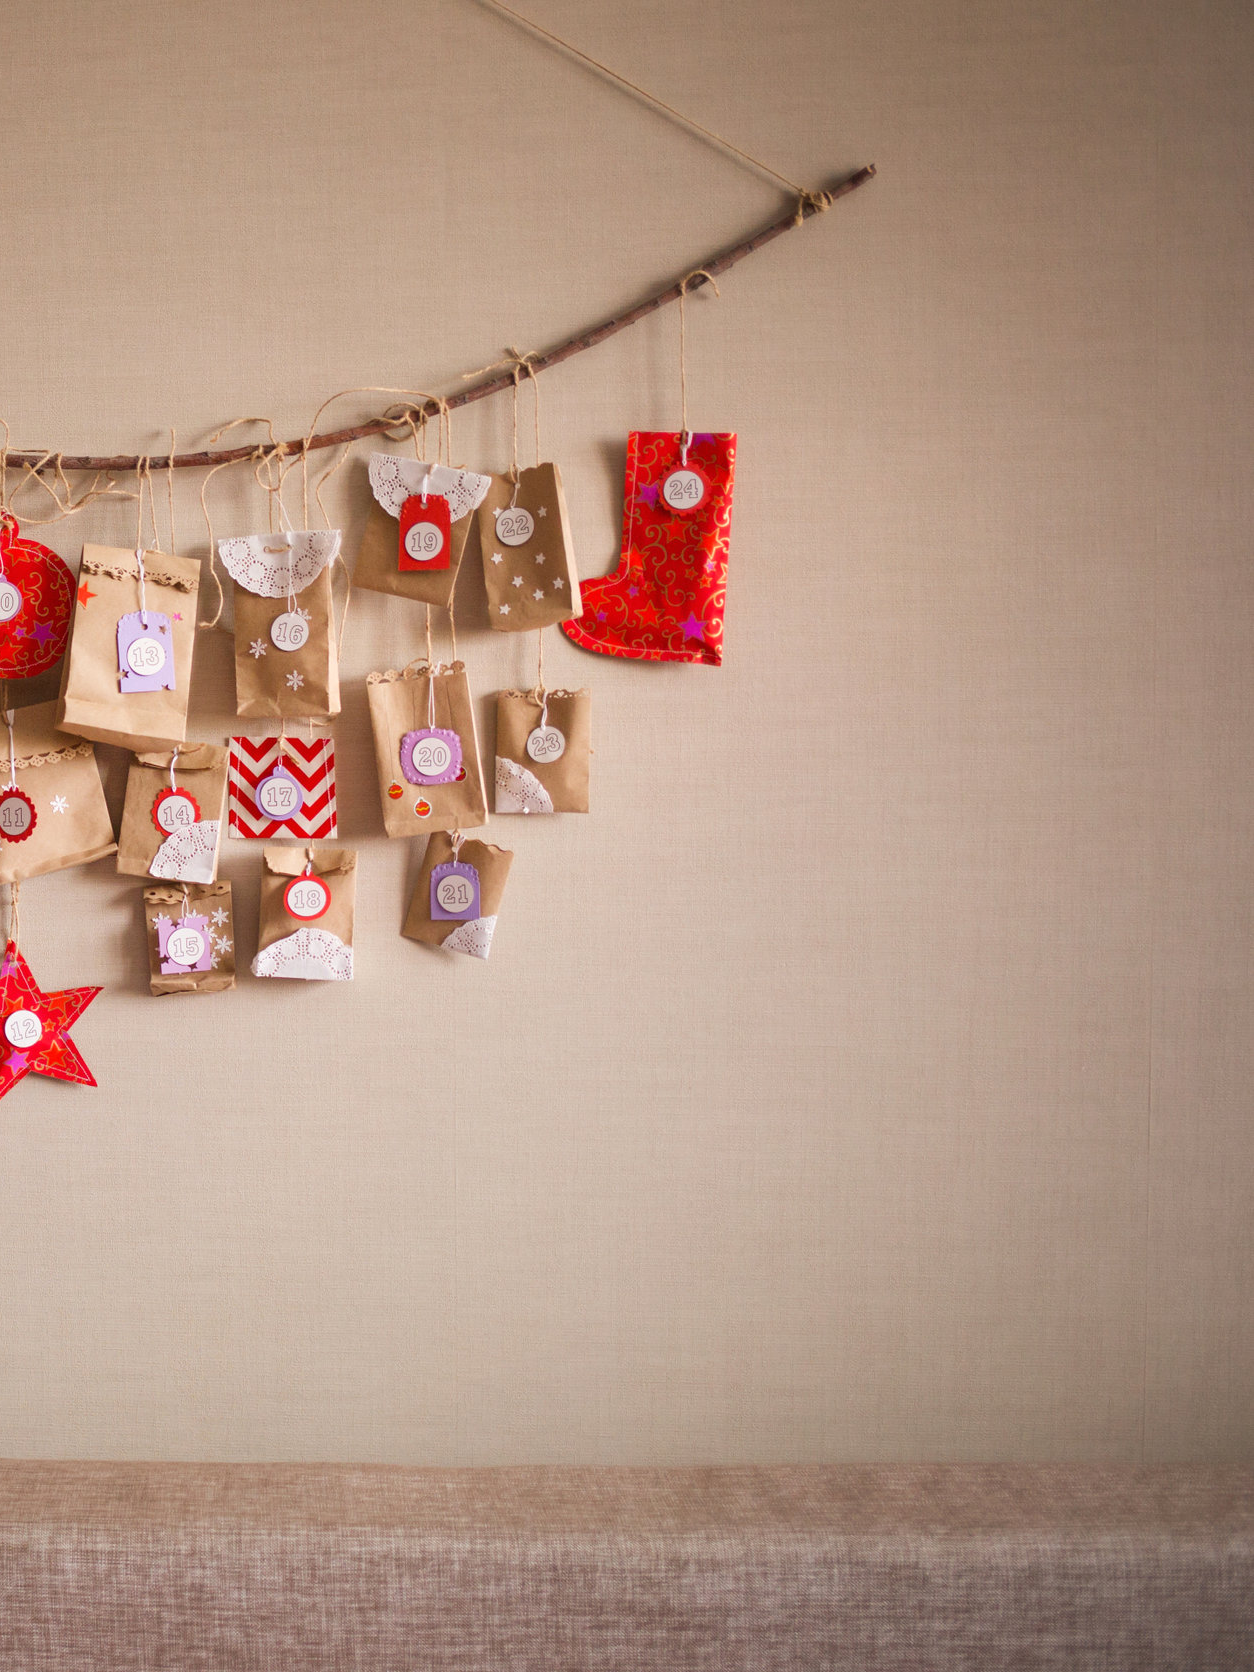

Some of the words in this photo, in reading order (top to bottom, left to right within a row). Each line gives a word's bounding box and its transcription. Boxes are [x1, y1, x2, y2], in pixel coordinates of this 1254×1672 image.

[668, 479, 698, 500] 24
[499, 517, 531, 538] 22
[410, 532, 438, 553] 19
[275, 622, 303, 644] 16
[132, 647, 160, 667] 13
[531, 734, 561, 756] 23
[417, 747, 447, 768] 20
[266, 787, 294, 807] 17
[2, 807, 25, 828] 11
[162, 806, 191, 826] 14
[296, 889, 322, 910] 18
[441, 884, 469, 904] 21
[171, 936, 200, 958] 15
[11, 1020, 38, 1042] 12
